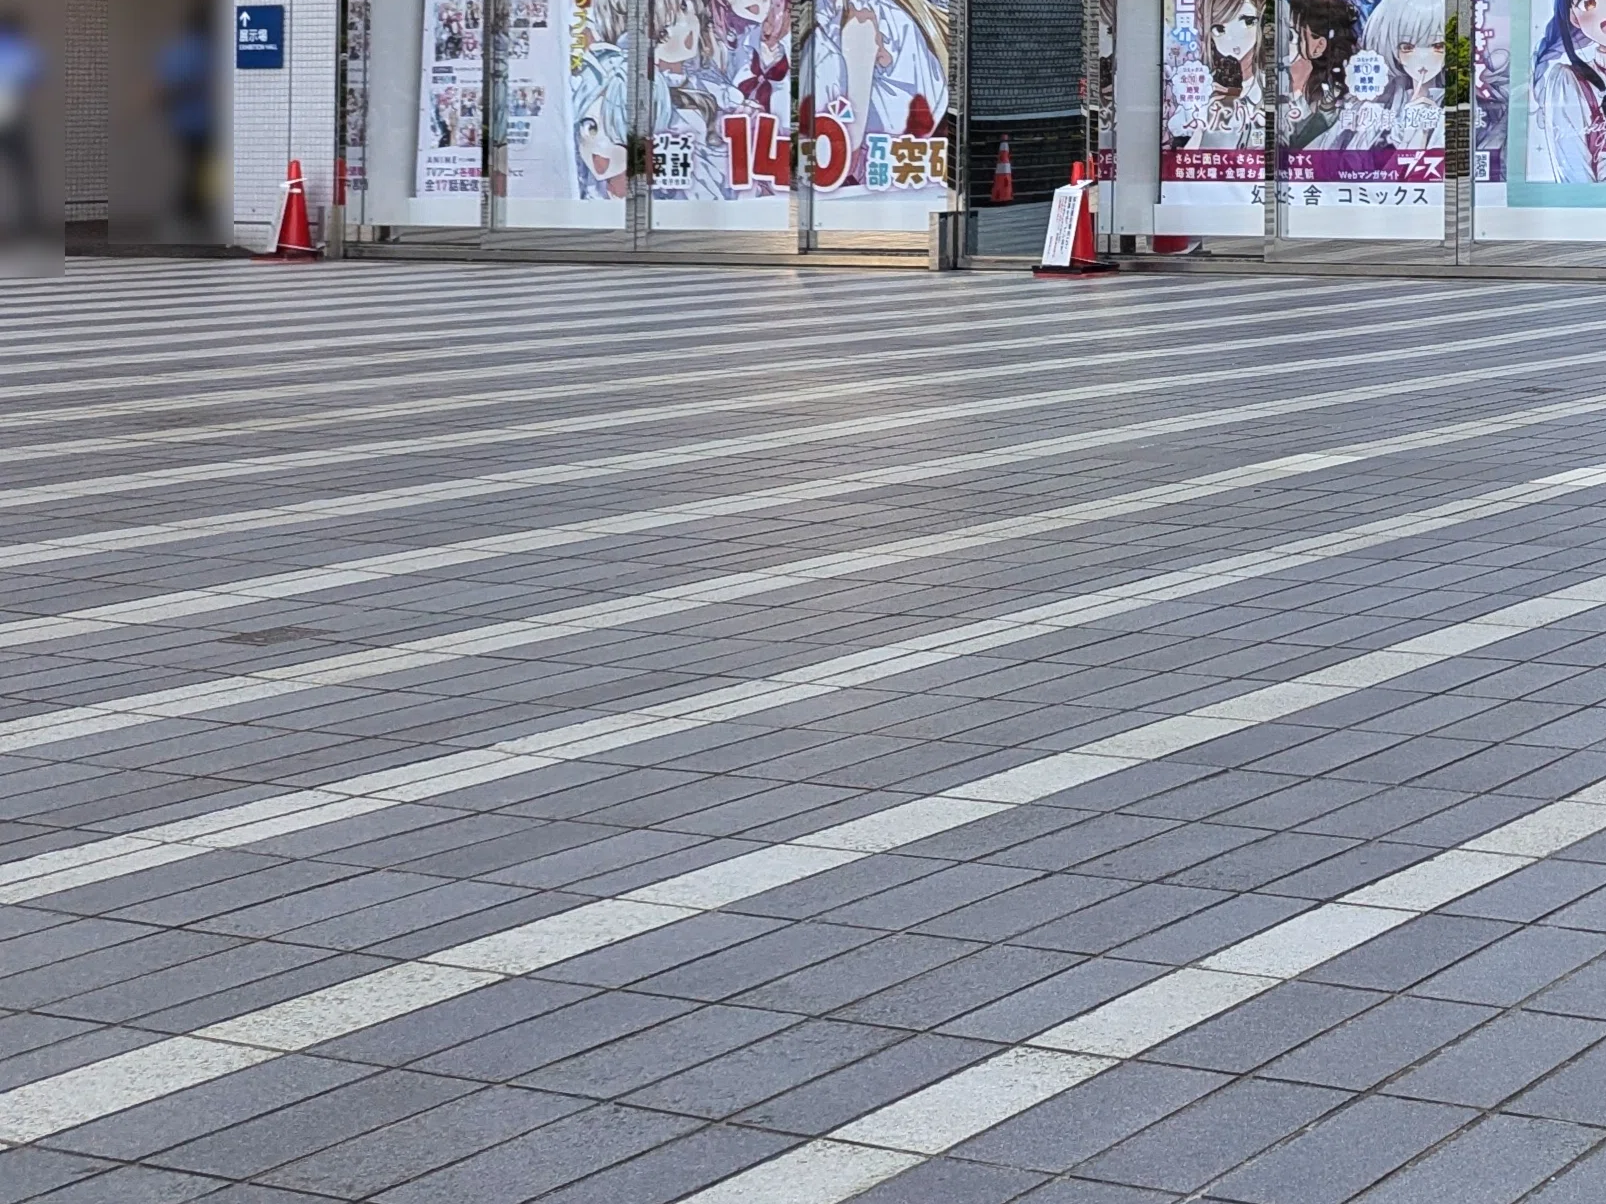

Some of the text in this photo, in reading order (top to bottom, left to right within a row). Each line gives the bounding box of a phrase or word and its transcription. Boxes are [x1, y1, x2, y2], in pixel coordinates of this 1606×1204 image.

[1338, 169, 1400, 180] Webマンガサイト
[1337, 186, 1428, 206] コミックス
